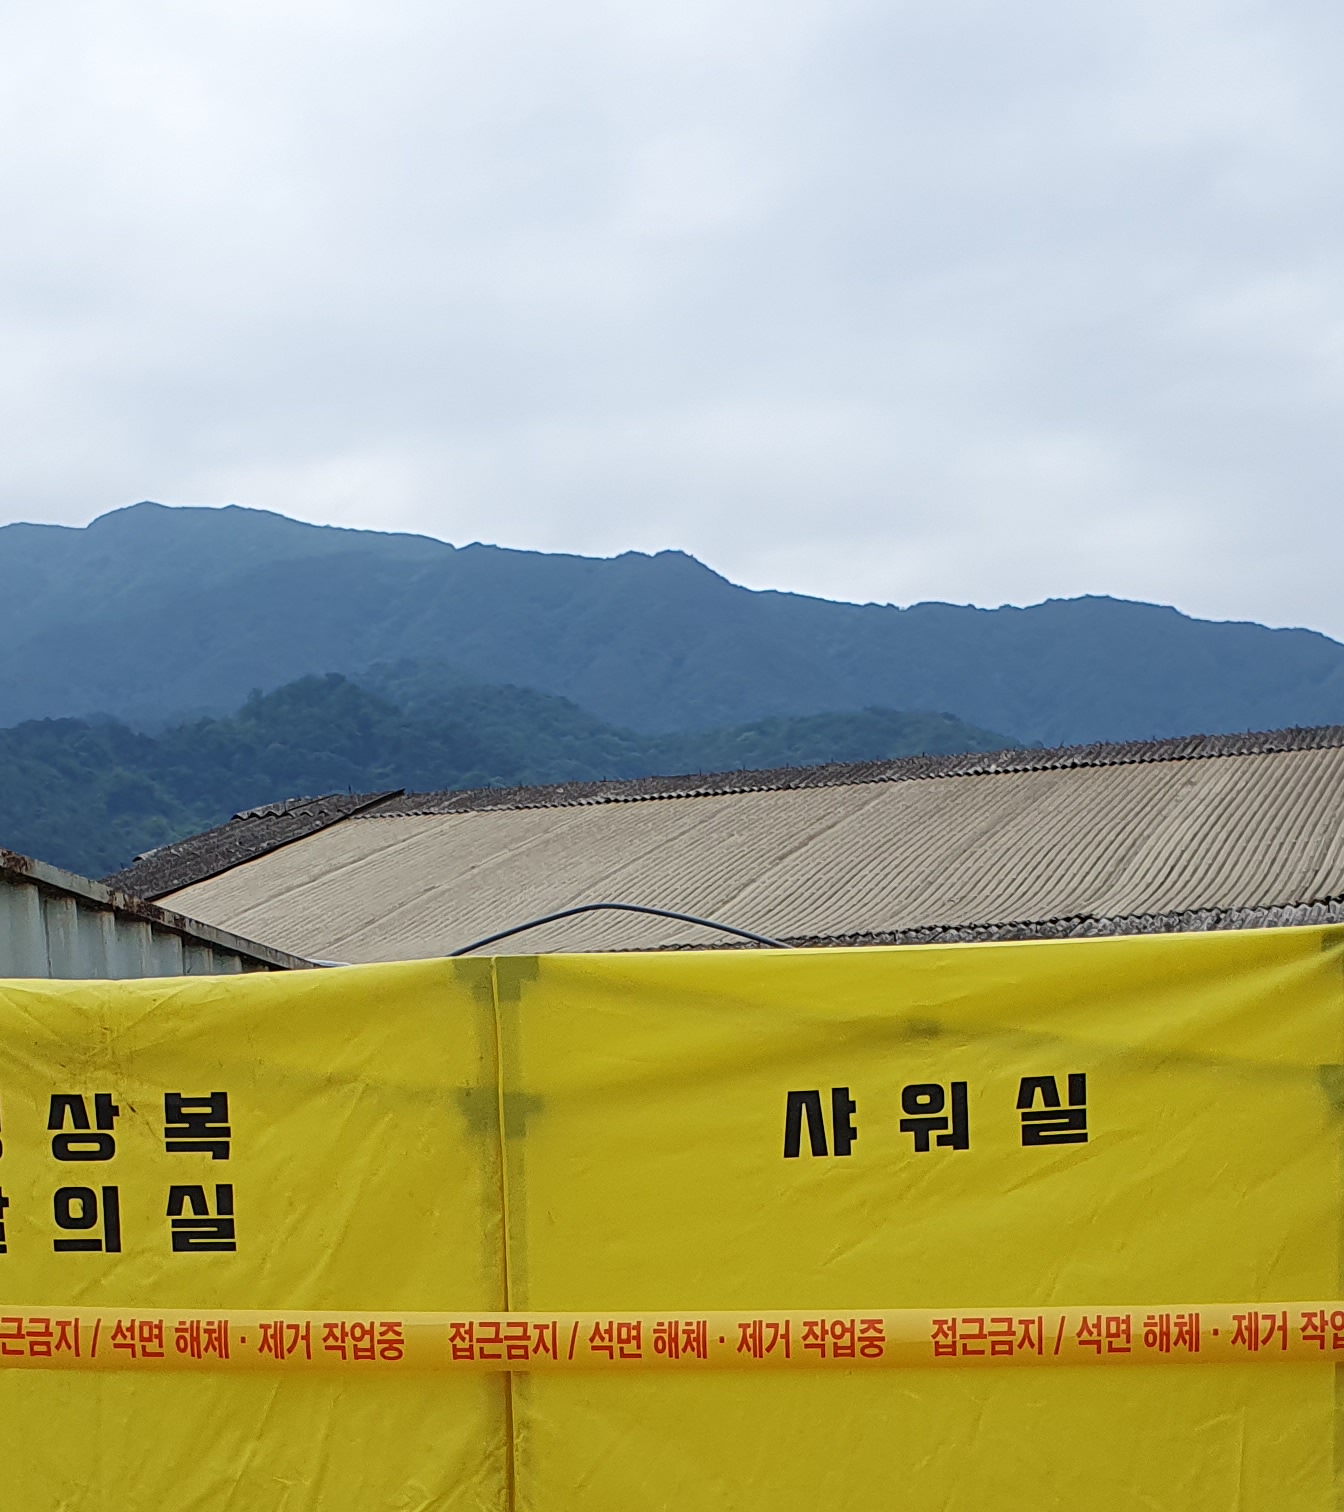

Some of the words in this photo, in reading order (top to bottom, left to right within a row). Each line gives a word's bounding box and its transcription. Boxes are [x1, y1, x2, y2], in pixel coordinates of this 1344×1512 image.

[111, 1321, 165, 1358] 석면
[175, 1321, 229, 1359] 해체
[259, 1322, 311, 1360] 제거
[323, 1322, 404, 1360] 작업중
[450, 1322, 558, 1360] 접근금지
[589, 1322, 642, 1360] 석면
[653, 1322, 707, 1359] 해체
[737, 1321, 790, 1359] 제거
[803, 1320, 885, 1359] 작업중
[932, 1317, 1043, 1357] 접근금지
[1077, 1316, 1131, 1355] 석면
[1144, 1314, 1200, 1353] 해체
[1232, 1312, 1288, 1352] 제거
